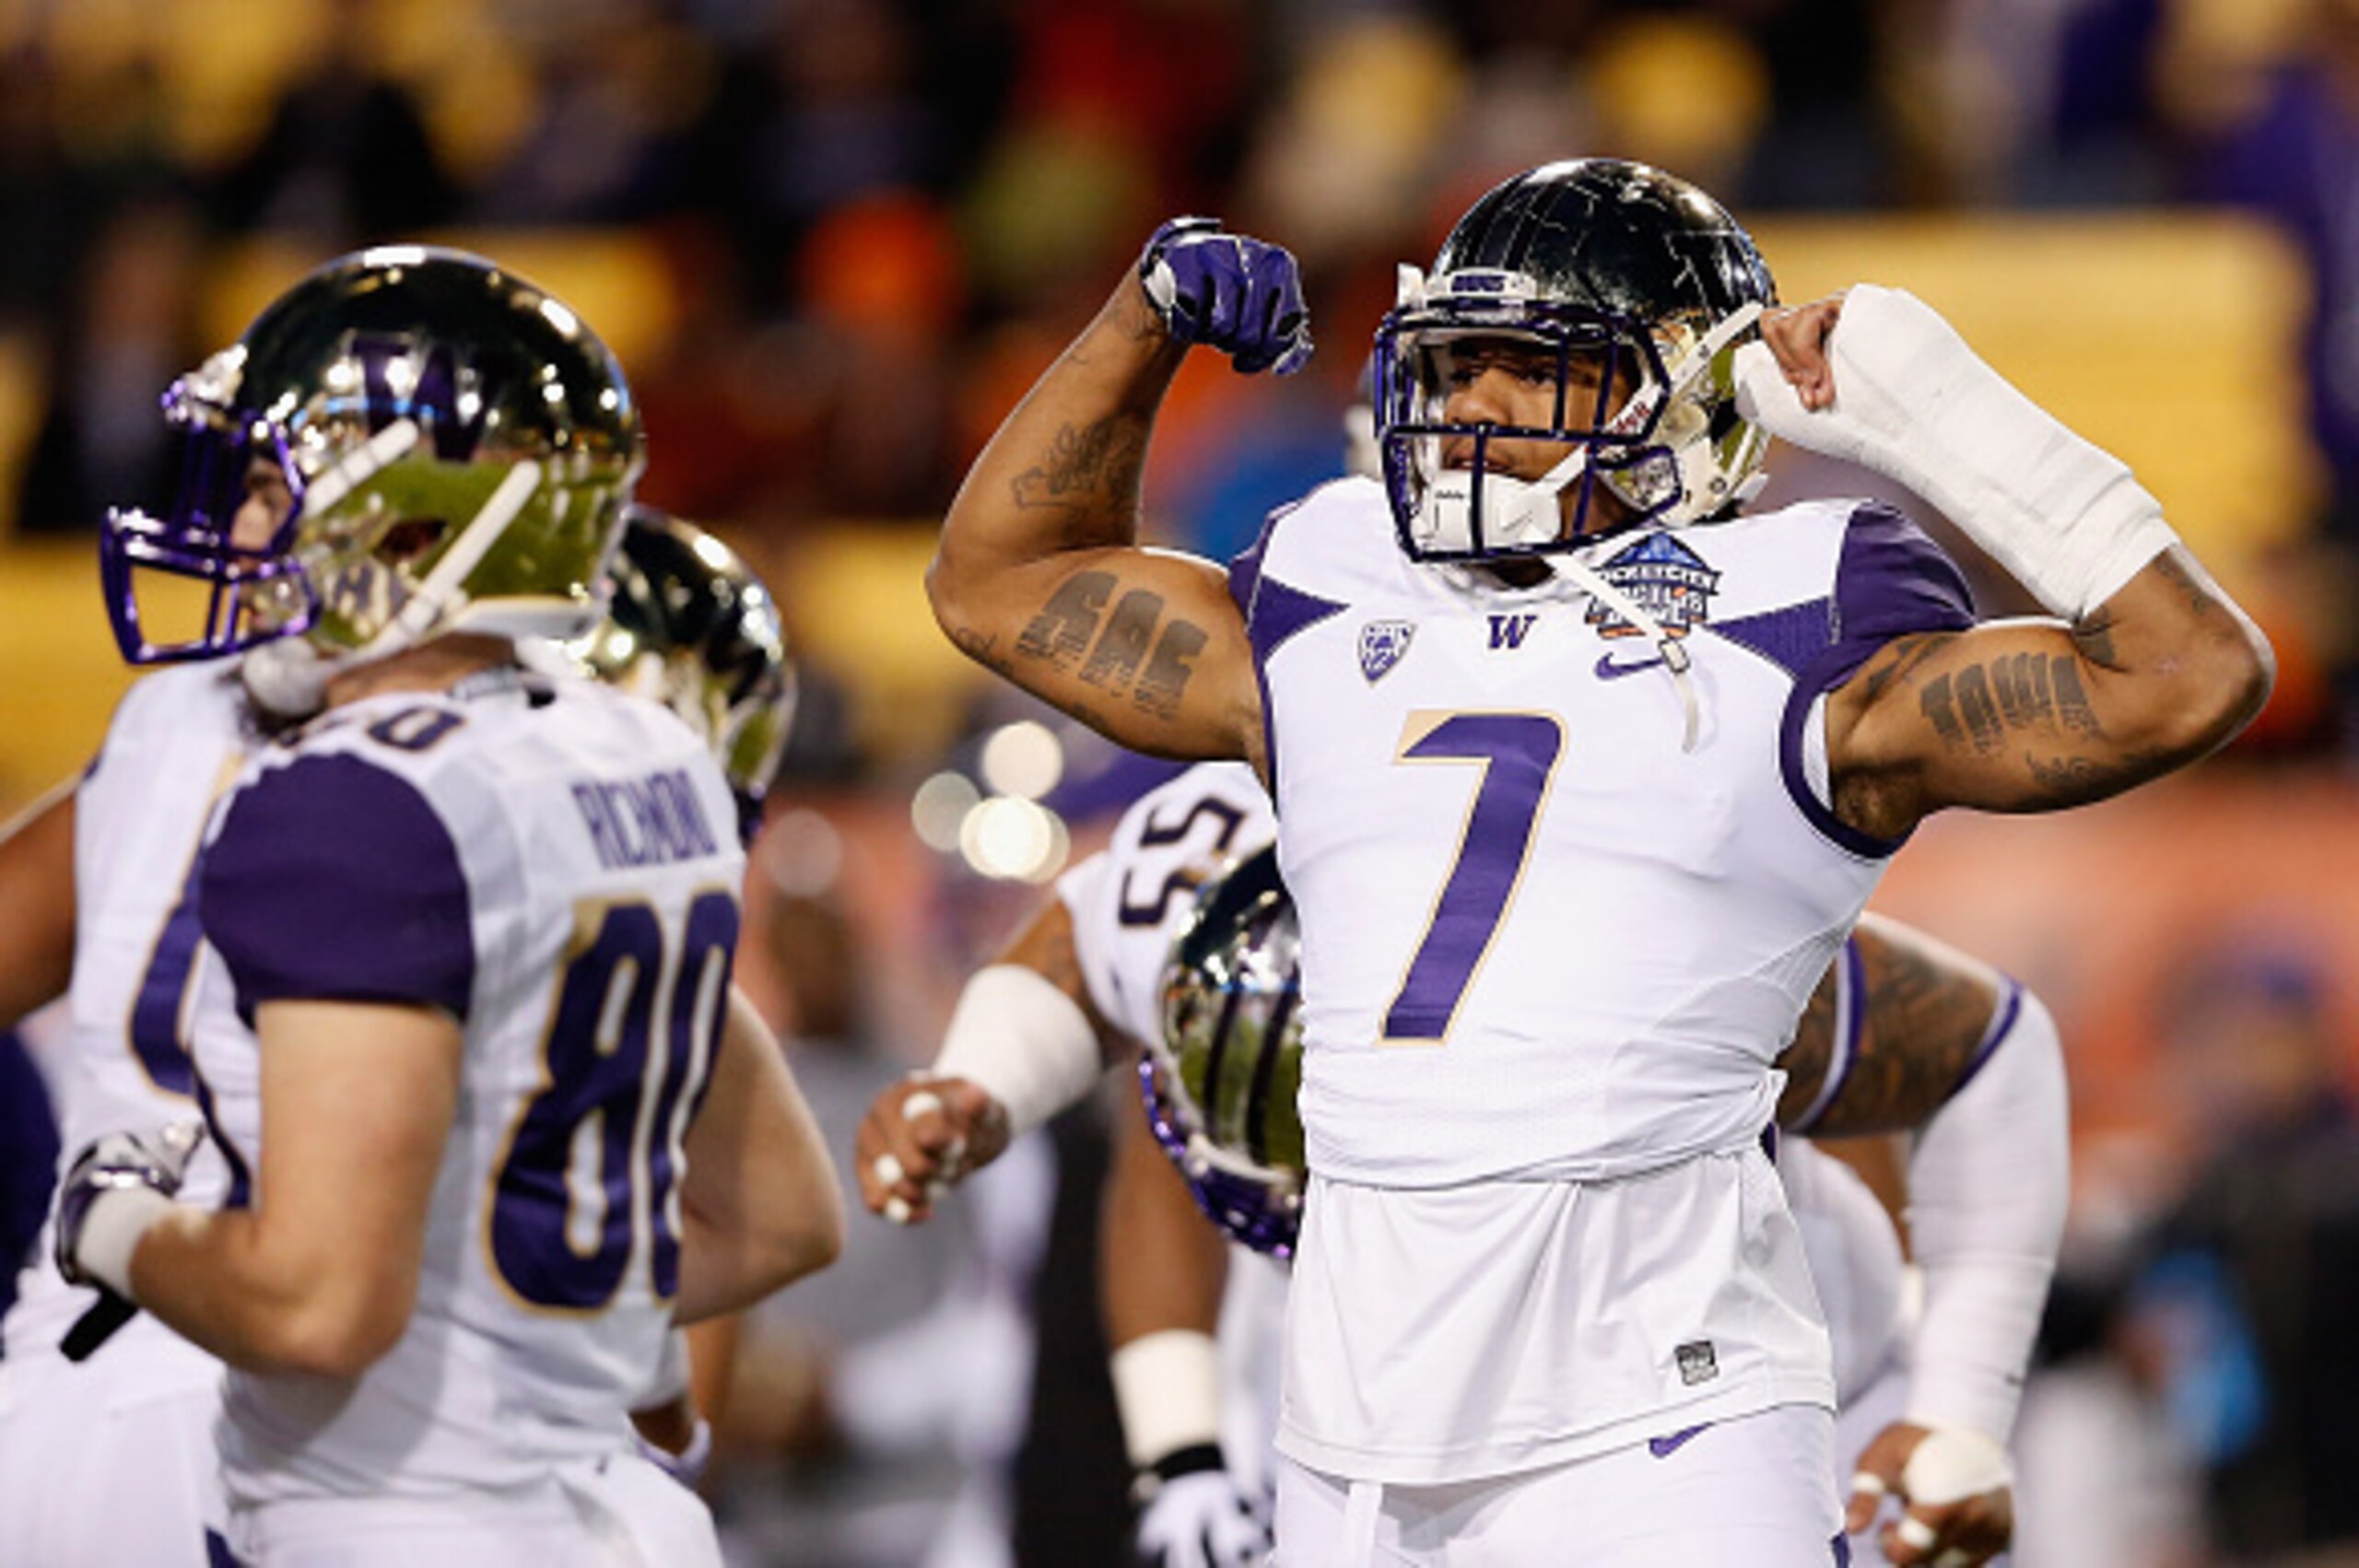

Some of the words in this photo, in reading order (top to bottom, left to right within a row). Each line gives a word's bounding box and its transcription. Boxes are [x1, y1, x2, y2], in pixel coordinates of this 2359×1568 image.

[1486, 614, 1537, 649] W
[1375, 708, 1570, 1048] 7
[484, 890, 741, 1317] 80
